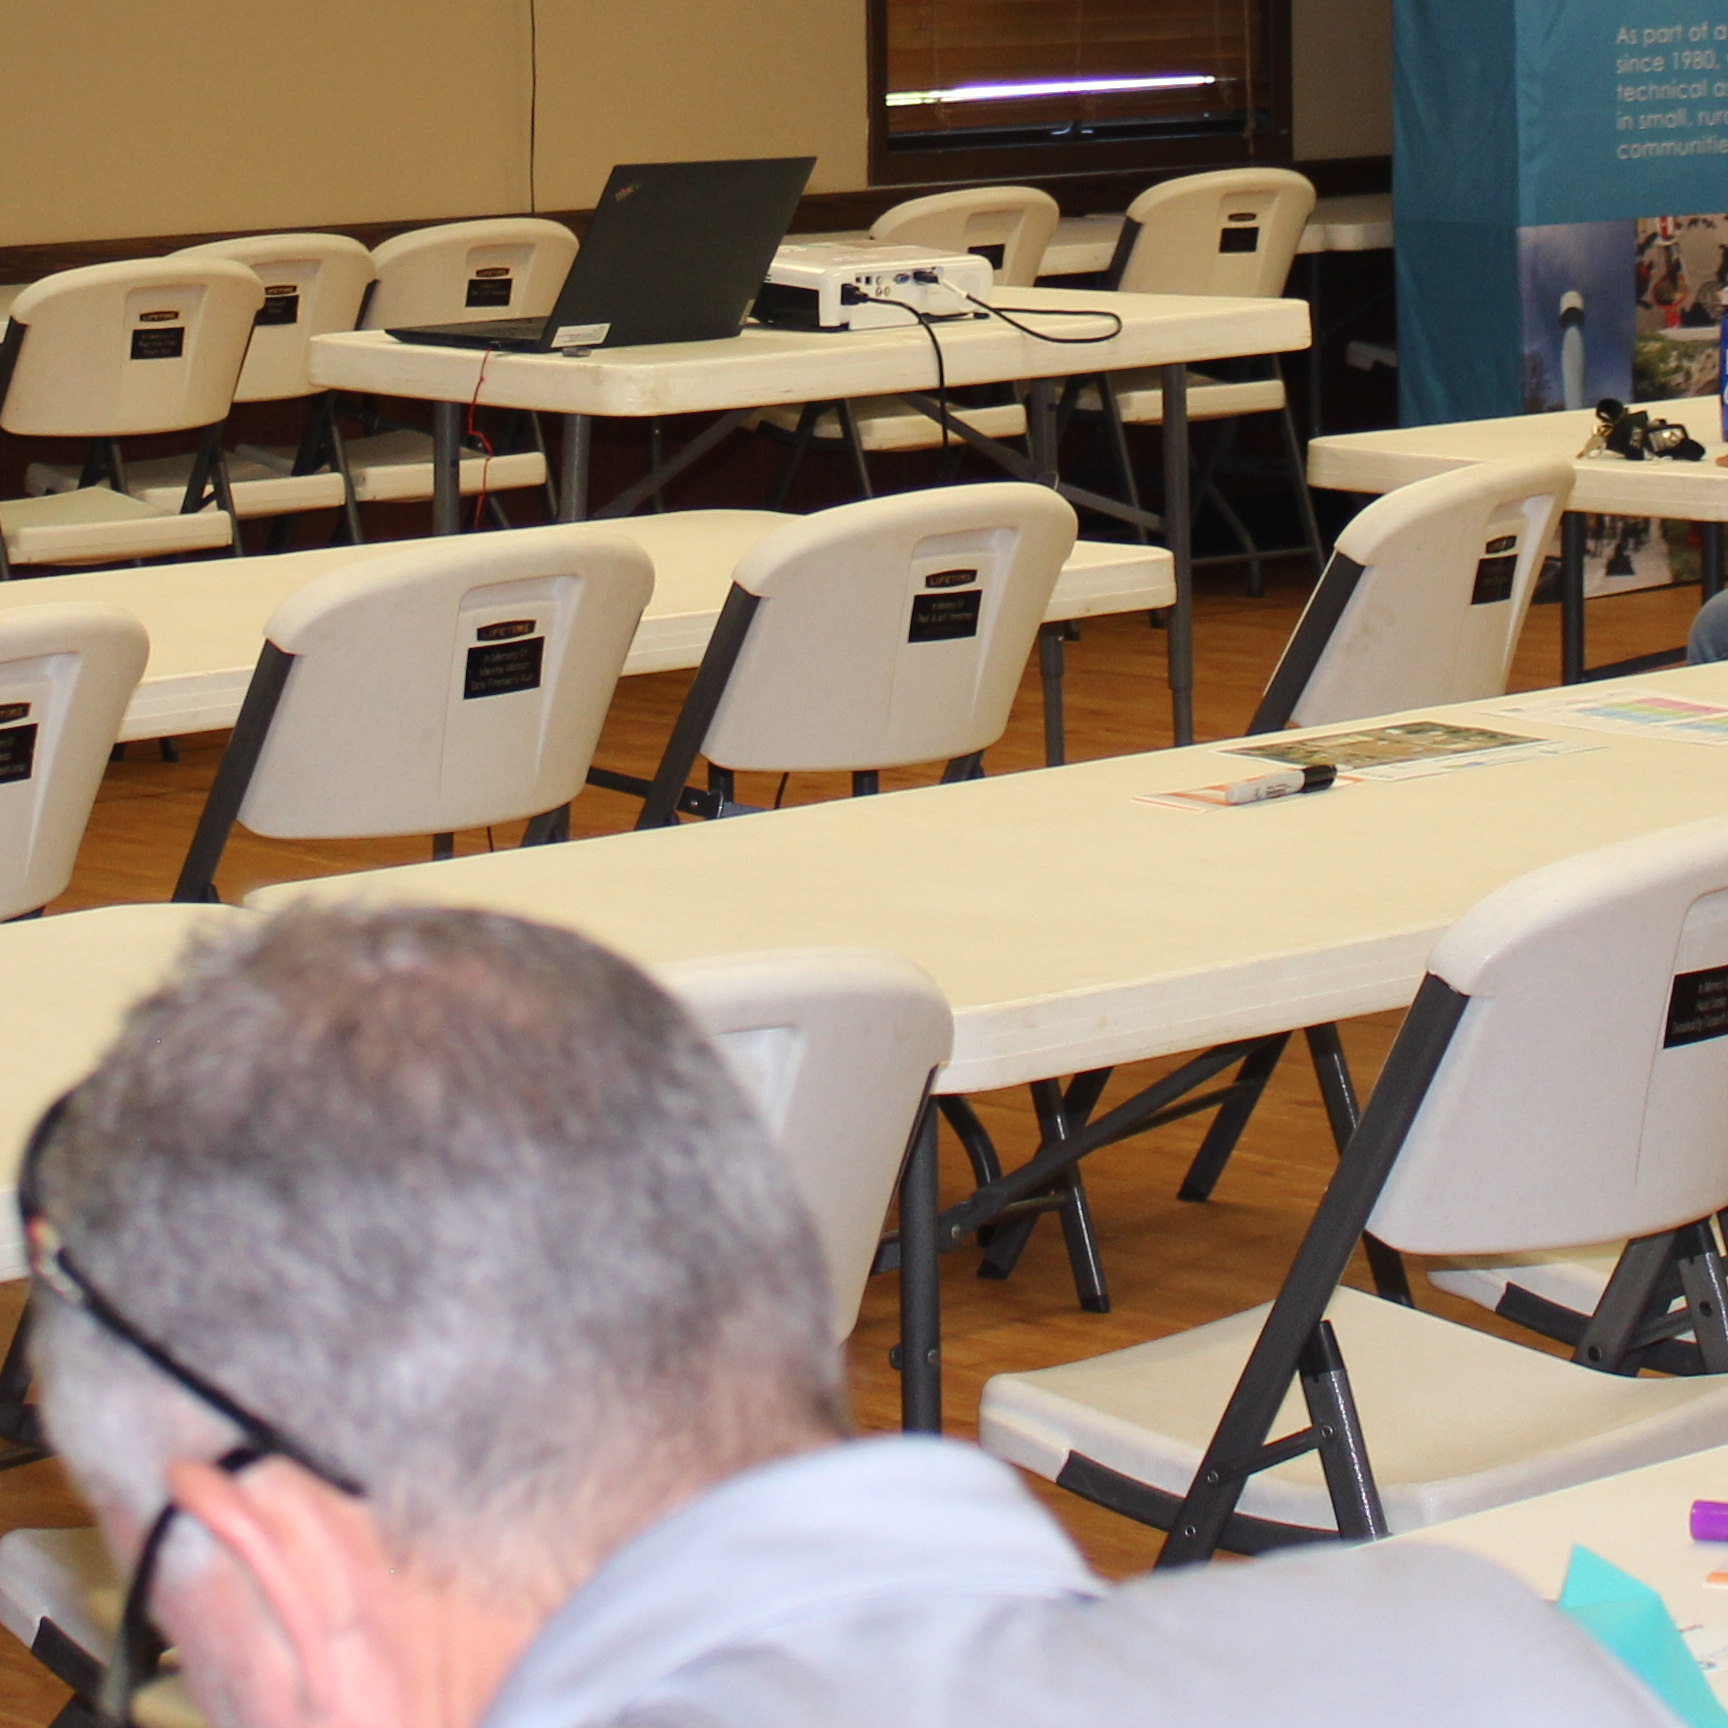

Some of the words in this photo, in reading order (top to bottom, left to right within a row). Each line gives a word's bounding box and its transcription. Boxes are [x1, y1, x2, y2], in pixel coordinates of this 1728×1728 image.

[1615, 26, 1639, 45] As
[1642, 24, 1682, 48] part
[1688, 22, 1710, 42] of
[1713, 26, 1727, 41] a
[1615, 53, 1665, 74] since
[1672, 49, 1721, 72] 1980,
[1616, 80, 1707, 103] technical
[1616, 112, 1634, 131] in
[1638, 108, 1693, 130] small,
